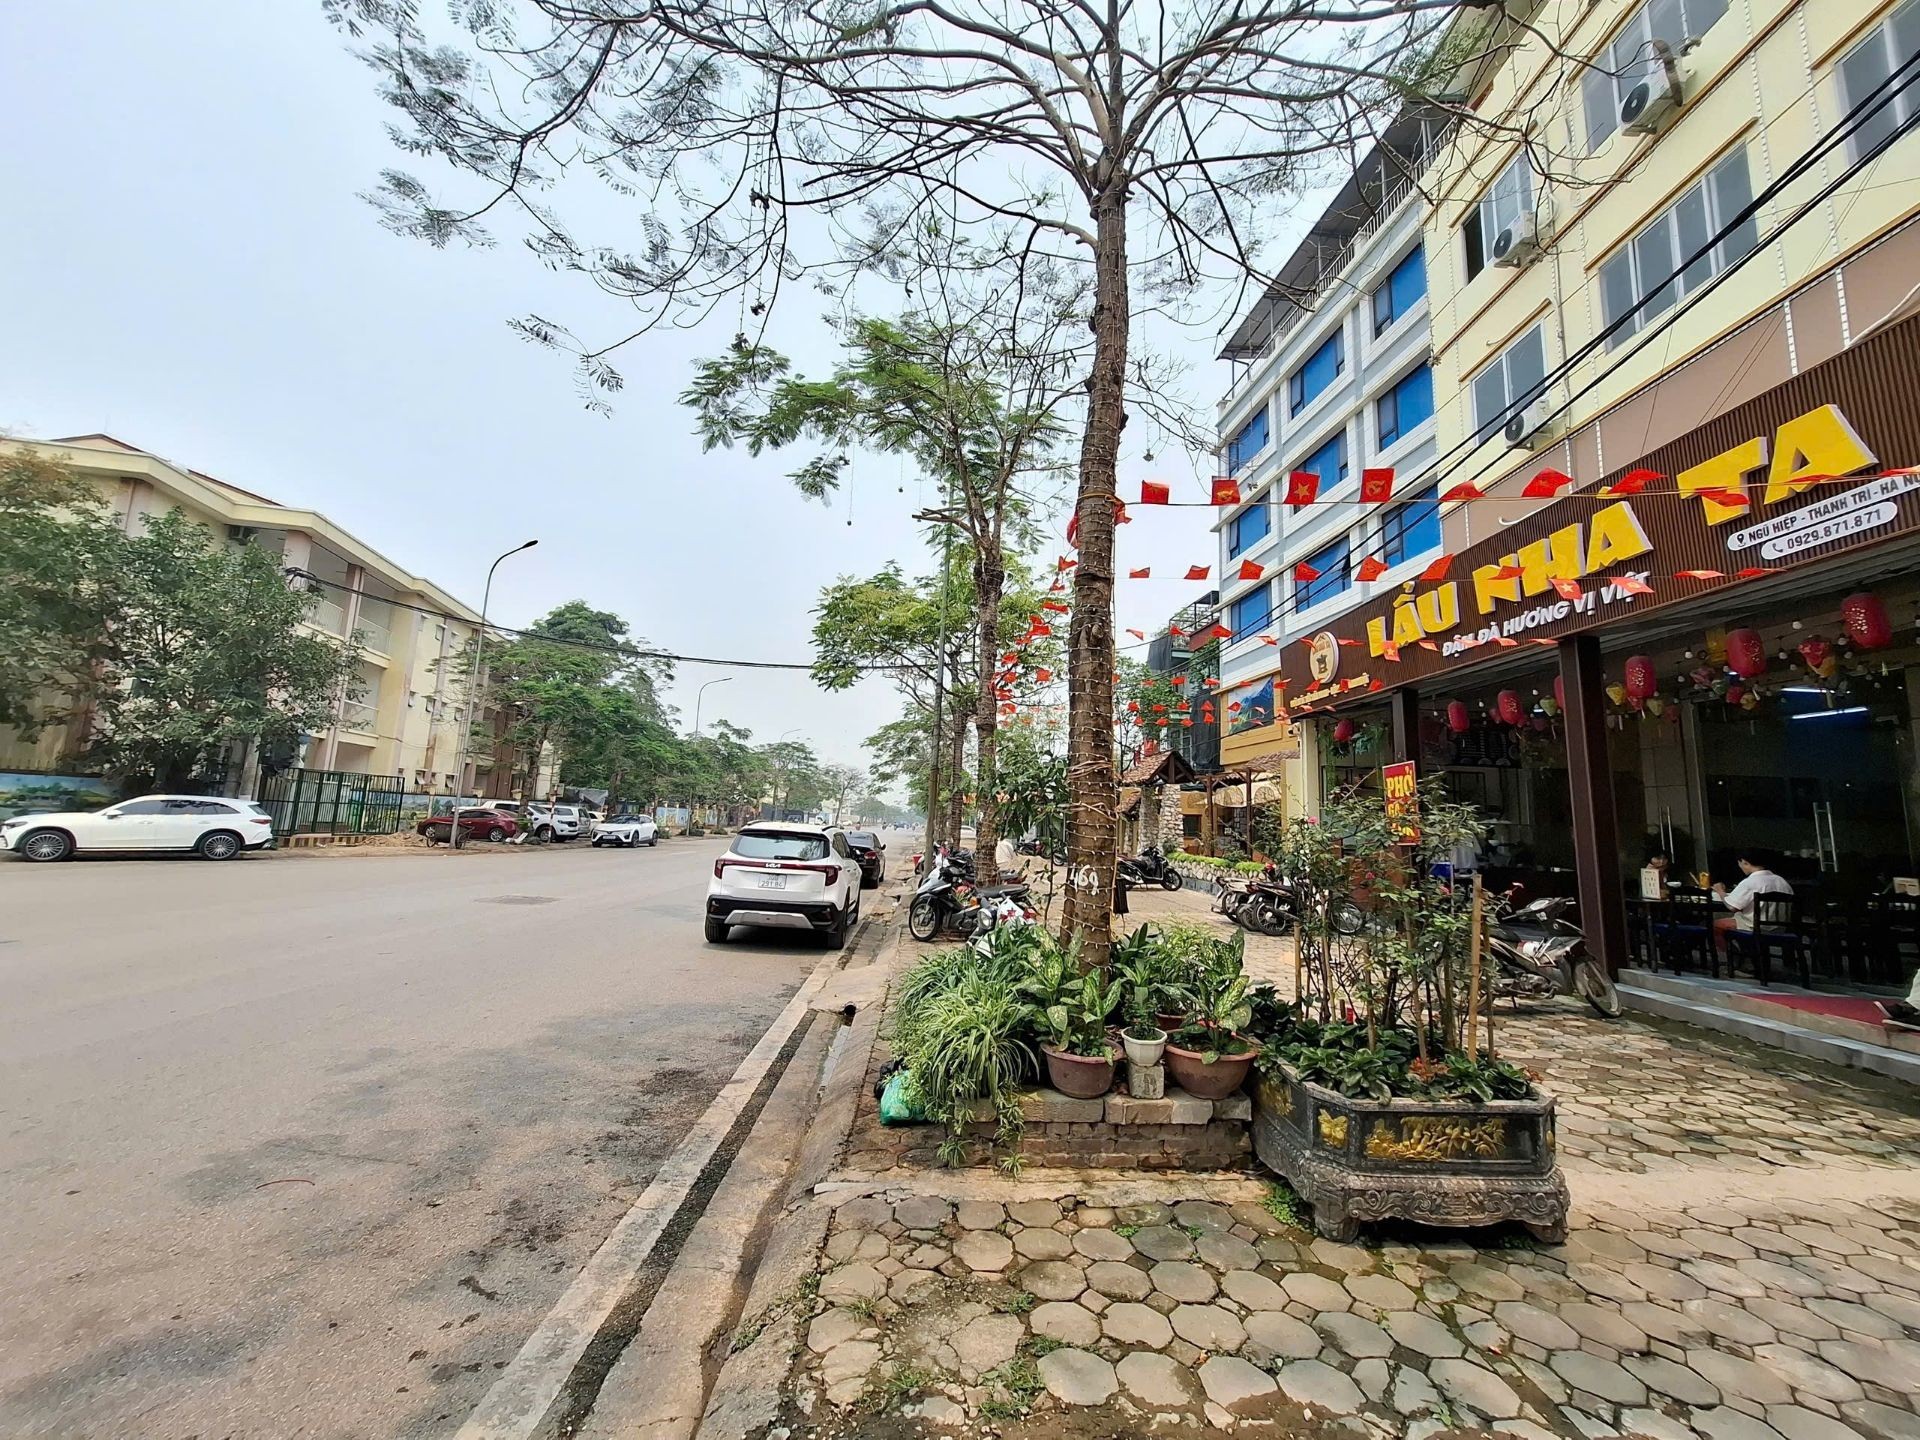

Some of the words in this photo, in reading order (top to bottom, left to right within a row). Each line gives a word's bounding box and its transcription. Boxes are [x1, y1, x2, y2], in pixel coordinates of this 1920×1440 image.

[1676, 403, 1880, 527] TA
[1772, 515, 1797, 533] HIỆP
[1807, 497, 1849, 521] THANH
[1879, 477, 1900, 496] HÀ
[1786, 508, 1882, 550] 0929.871.871
[1502, 601, 1571, 637] HƯƠNG
[1572, 590, 1598, 616] VỊ
[1386, 765, 1415, 799] PHỞ
